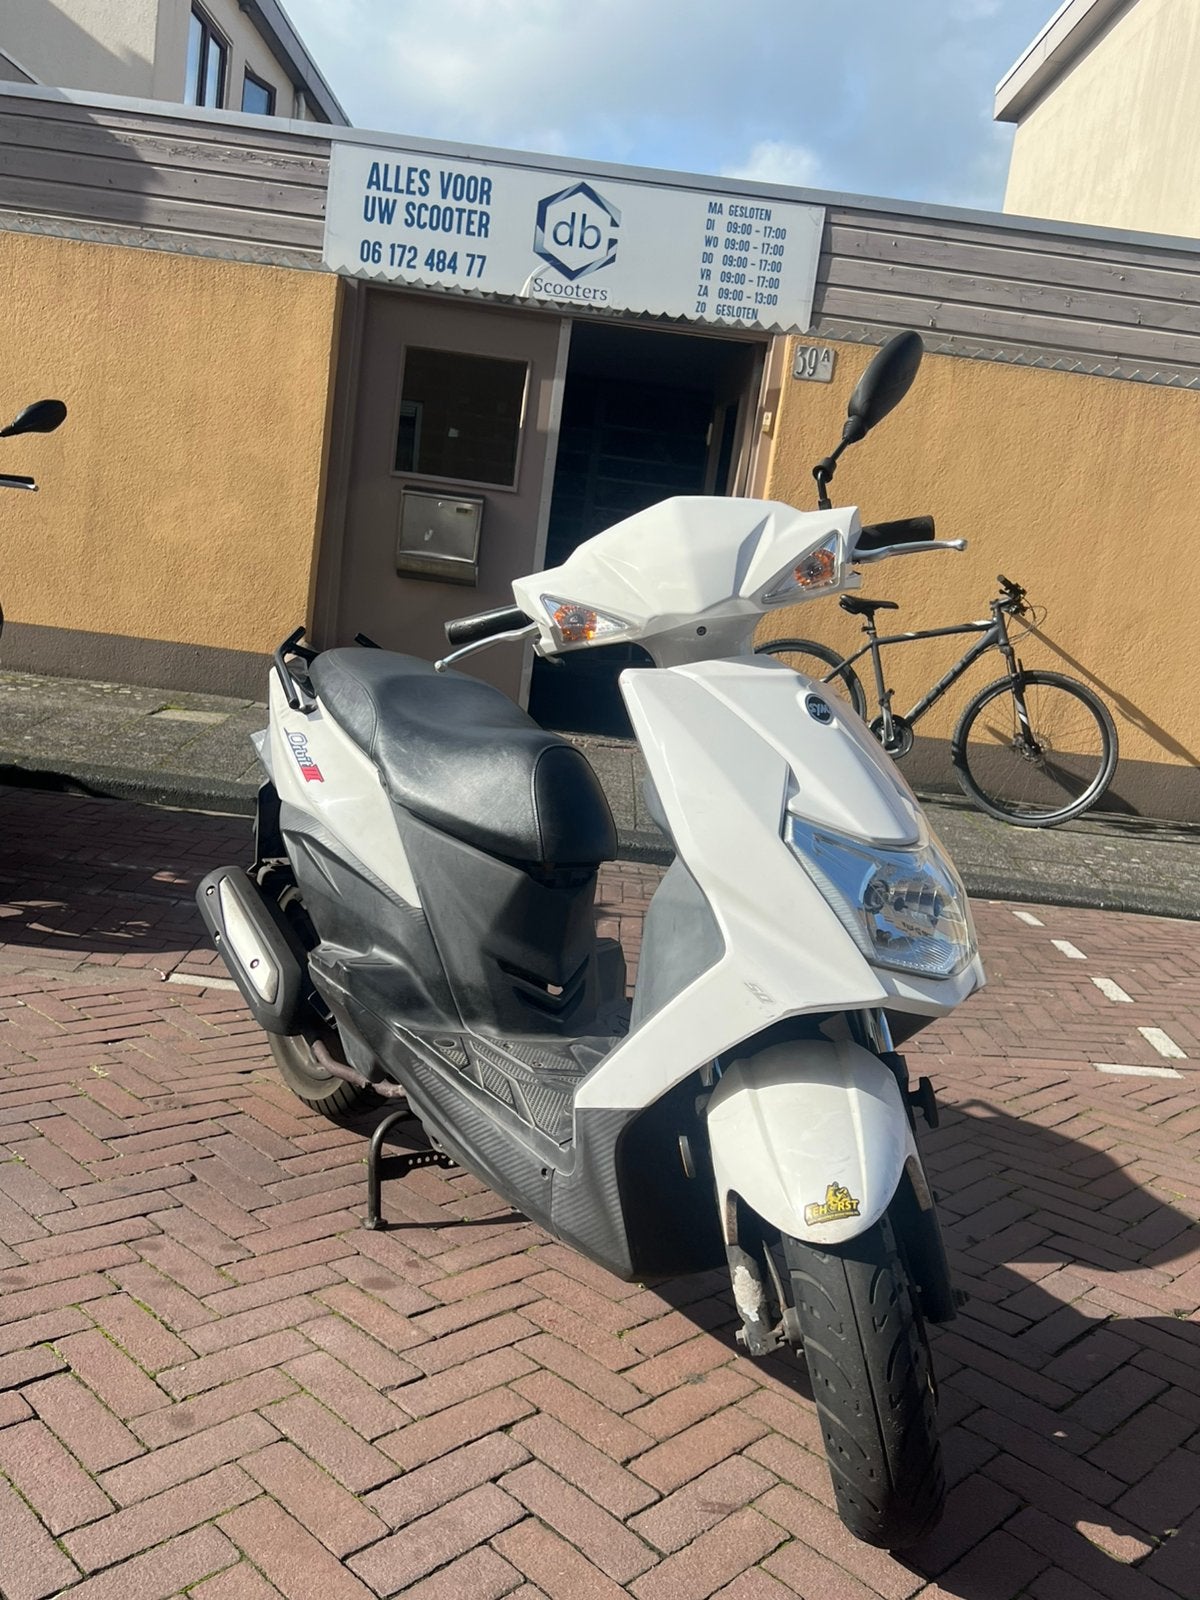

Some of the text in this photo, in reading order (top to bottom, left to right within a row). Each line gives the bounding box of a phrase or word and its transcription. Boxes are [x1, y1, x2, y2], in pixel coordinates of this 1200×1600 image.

[367, 162, 492, 205] ALLES VOOR
[364, 195, 490, 238] UW SCOOTER
[708, 202, 771, 221] MA GESLOTEN
[552, 212, 601, 250] db
[706, 219, 715, 230] DI
[727, 222, 752, 235] 09:00
[764, 226, 786, 239] 17:00
[705, 235, 718, 248] WO
[725, 238, 750, 252] 09:00
[762, 243, 784, 256] 17:00
[360, 240, 486, 278] 06 172 484 77
[702, 252, 713, 264] DO
[722, 255, 748, 268] 09:00
[759, 259, 782, 272] 17:00
[700, 268, 711, 280] VR
[720, 271, 745, 285] 09:00
[757, 276, 779, 289] 17:00
[533, 278, 608, 301] Scooters
[698, 285, 708, 297] ZA
[718, 288, 743, 301] 09:00
[755, 292, 778, 305] 13:00
[696, 302, 758, 320] ZO GESLOTEN
[808, 702, 832, 716] SYM
[284, 731, 314, 766] Orbit
